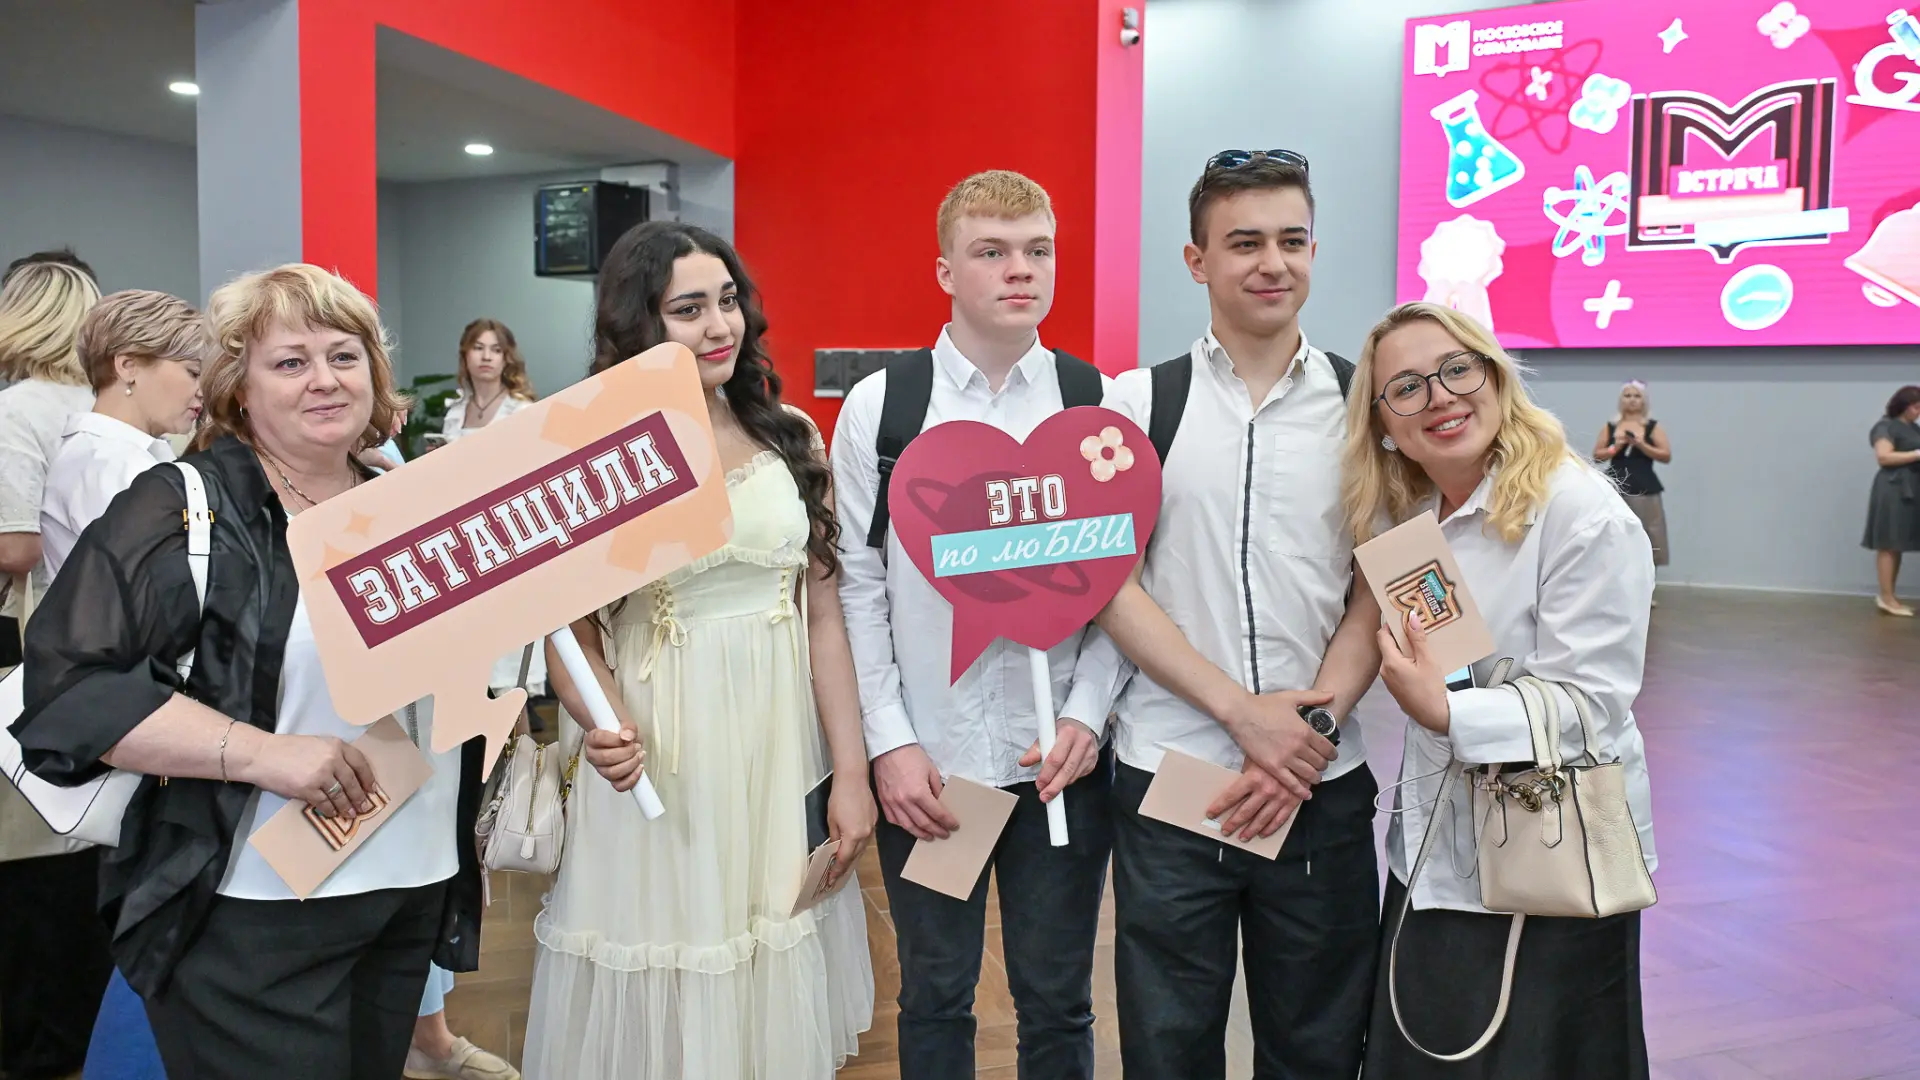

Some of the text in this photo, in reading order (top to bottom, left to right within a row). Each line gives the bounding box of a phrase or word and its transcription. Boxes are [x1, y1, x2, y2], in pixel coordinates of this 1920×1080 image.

[1677, 165, 1779, 193] ВСТРЕЧА
[986, 474, 1067, 526] ЭТО
[346, 431, 678, 624] ЗАТАЩИЛА
[938, 544, 978, 568] по
